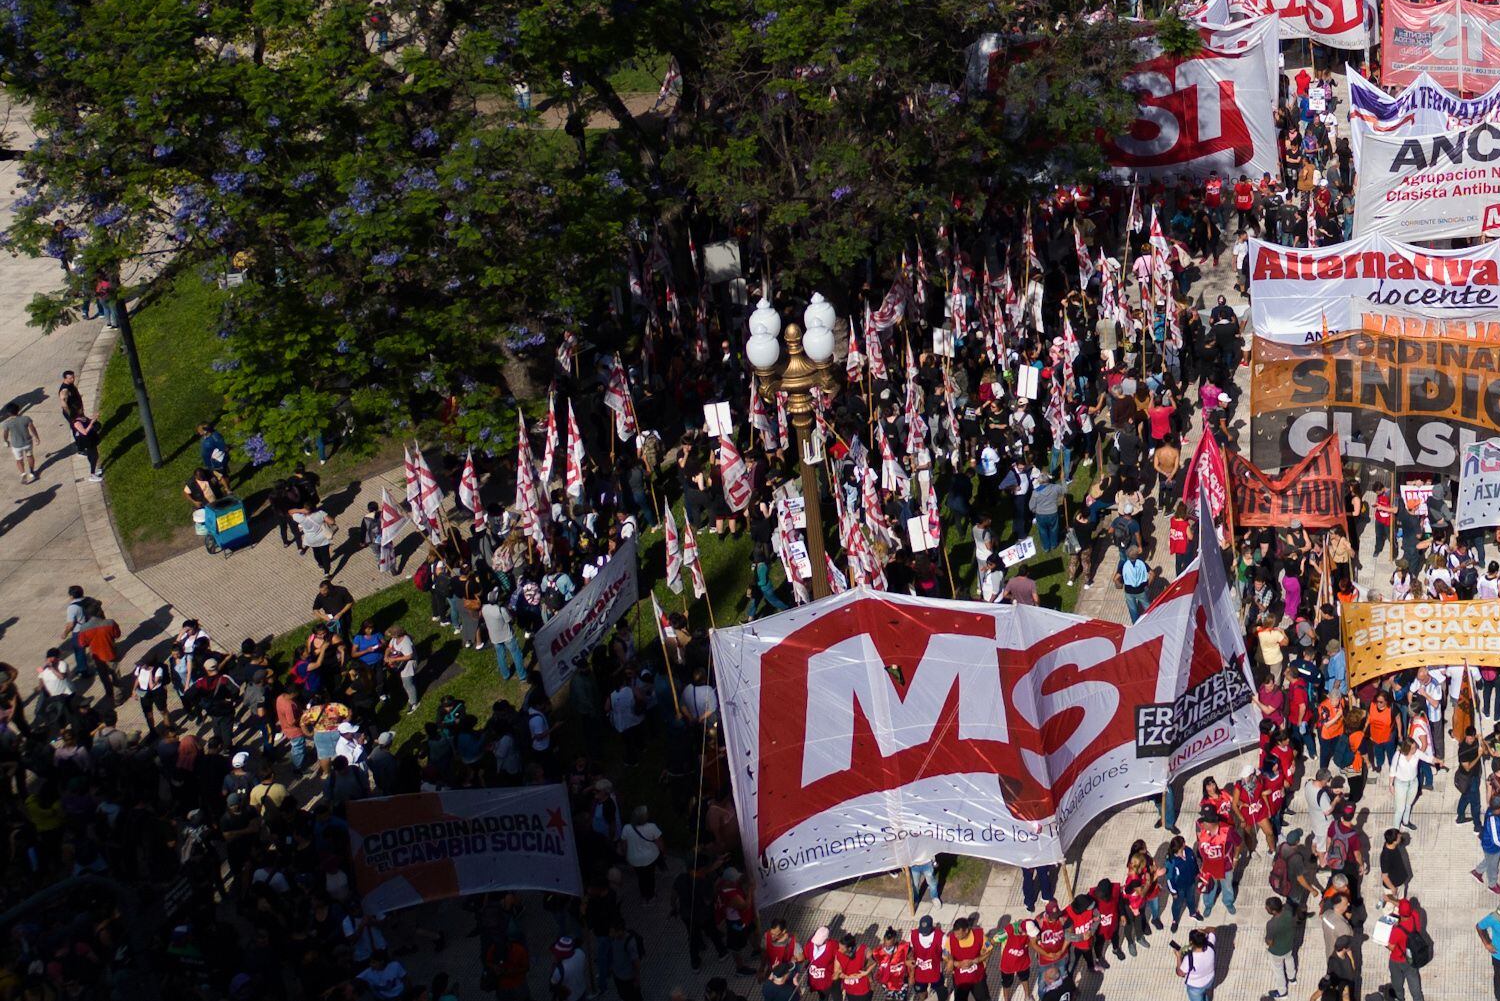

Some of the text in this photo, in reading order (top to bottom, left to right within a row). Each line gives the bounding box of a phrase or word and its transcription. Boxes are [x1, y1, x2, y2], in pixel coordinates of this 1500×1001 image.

[1386, 187, 1448, 202] Clasista
[1400, 167, 1486, 187] Agrupación
[1252, 246, 1500, 286] Alternativa
[1367, 278, 1498, 306] docente
[800, 585, 1203, 791] MST
[1138, 672, 1224, 727] FRENTE
[1168, 727, 1226, 773] UNIDAD
[363, 813, 545, 855] COORDINADORA
[391, 830, 566, 868] CAMBIO SOCIAL
[757, 829, 876, 880] Movimiento
[881, 824, 974, 843] Socialista
[981, 823, 1006, 842] de
[1013, 822, 1039, 843] los
[367, 852, 390, 865] POR
